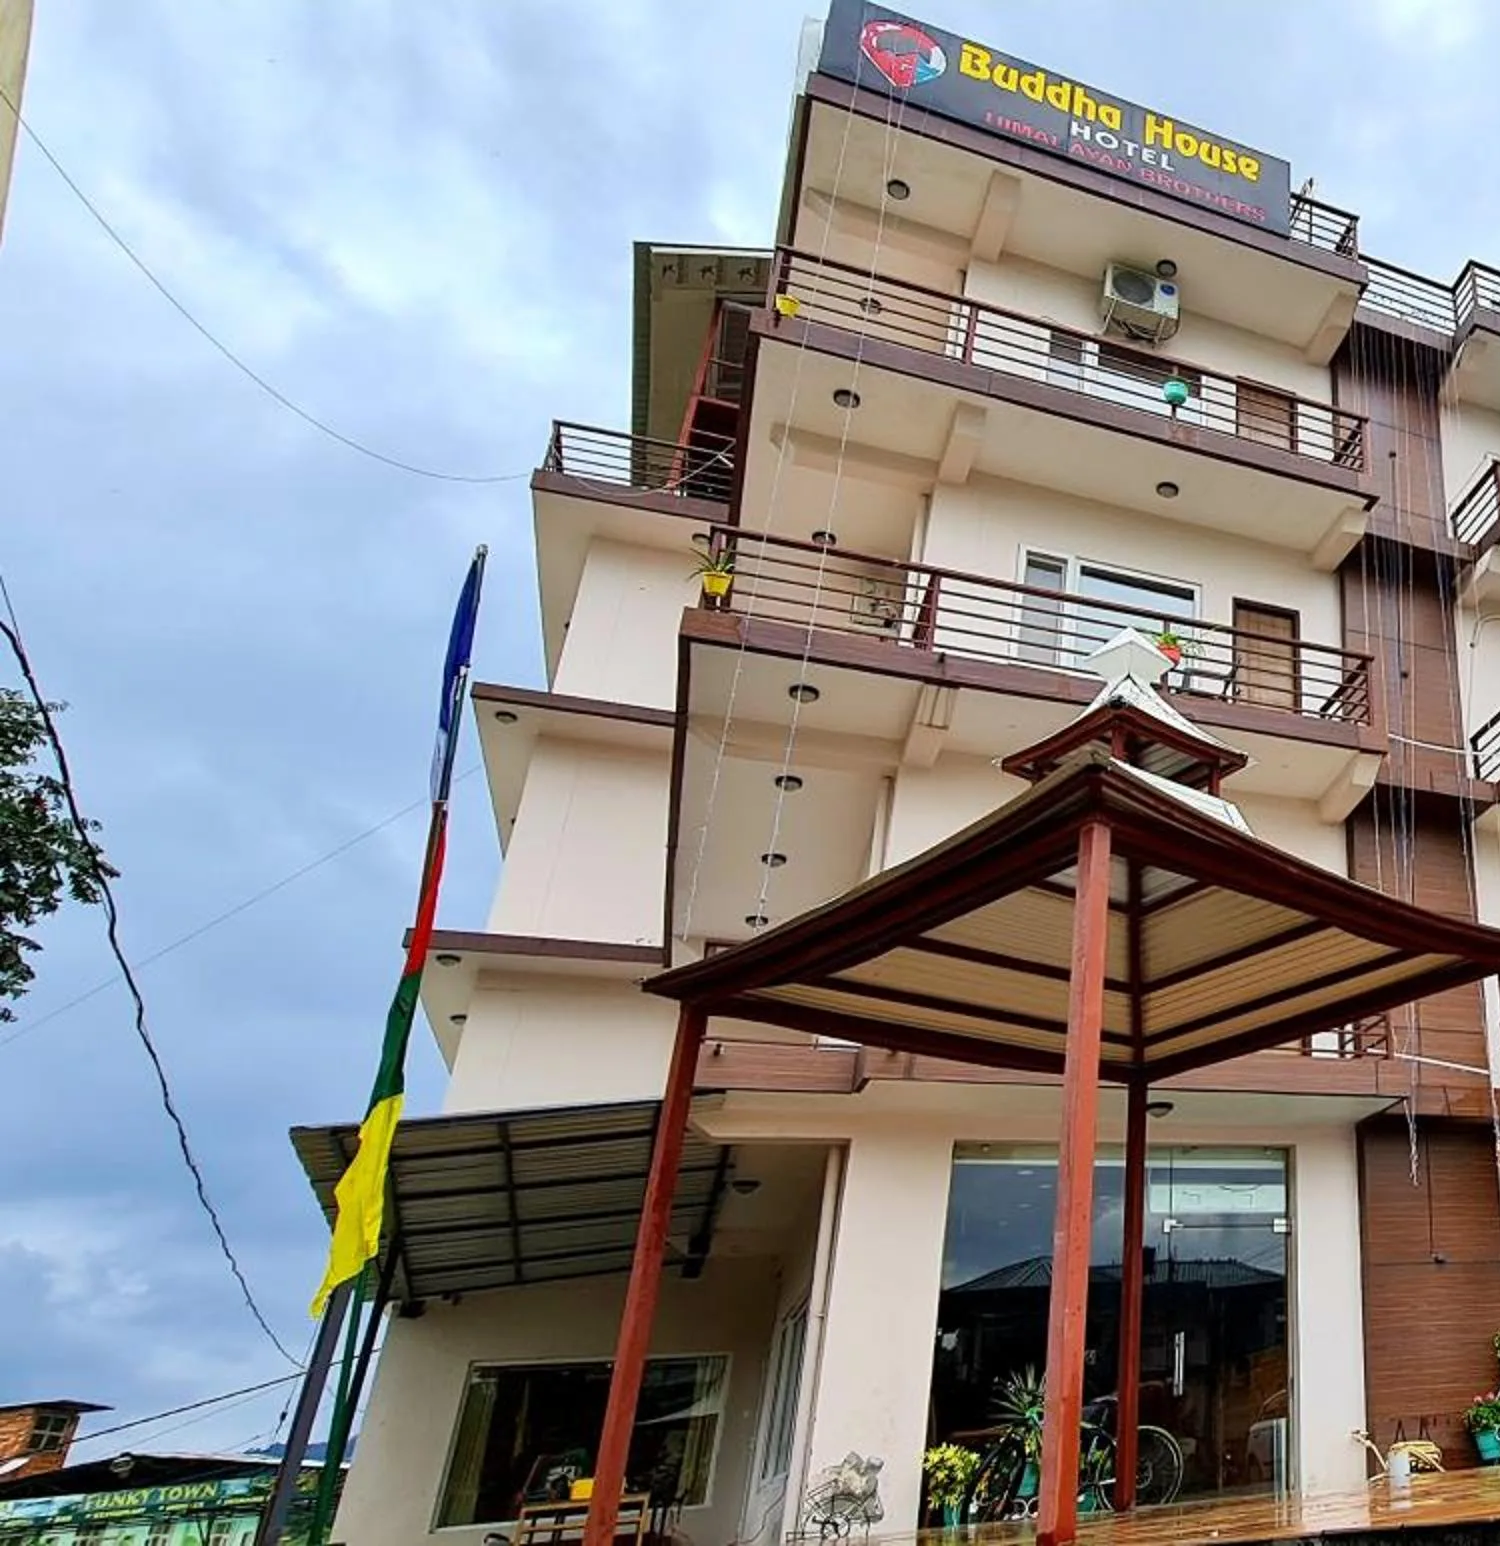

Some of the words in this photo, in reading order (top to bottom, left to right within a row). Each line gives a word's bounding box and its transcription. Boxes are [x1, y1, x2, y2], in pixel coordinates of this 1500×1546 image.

[959, 41, 1121, 132] Buddha
[1144, 113, 1261, 182] House
[1070, 121, 1175, 171] HOTEL
[1141, 169, 1266, 221] BROTHERS
[158, 1480, 219, 1501] TOWN
